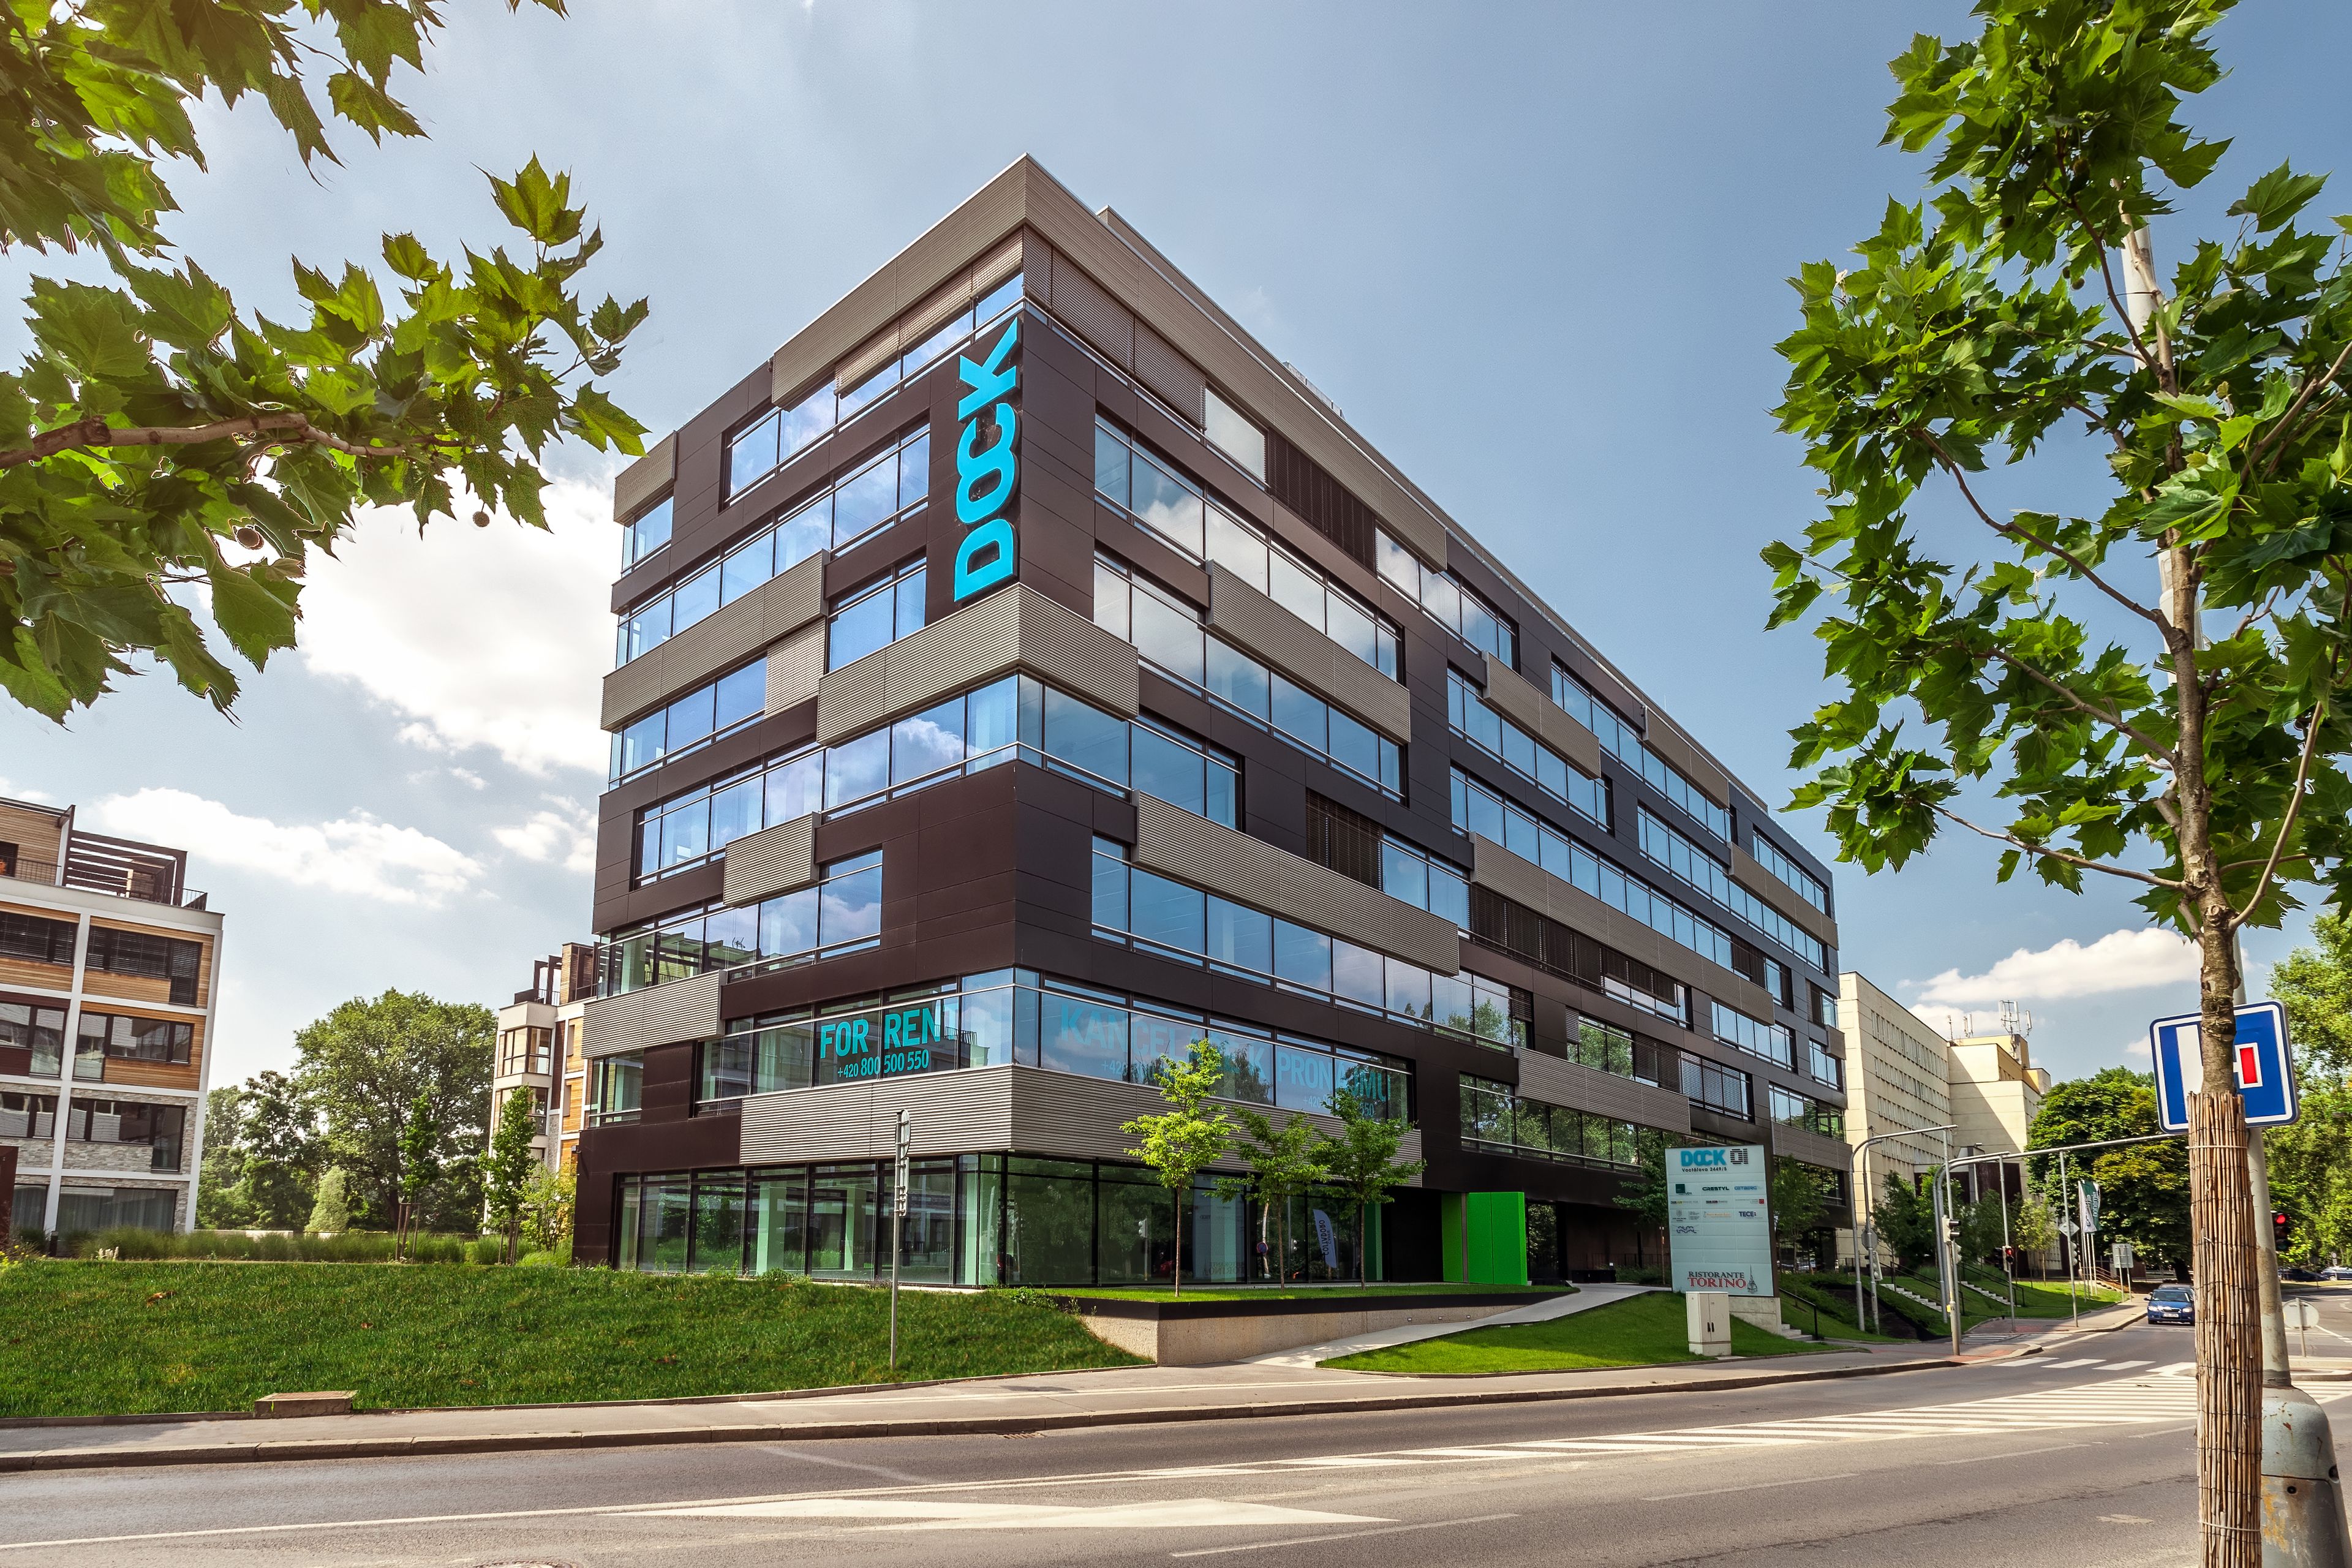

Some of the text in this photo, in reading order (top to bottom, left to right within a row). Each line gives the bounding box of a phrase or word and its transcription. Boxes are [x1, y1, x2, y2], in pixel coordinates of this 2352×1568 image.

[954, 316, 1020, 602] DOCK
[820, 1018, 870, 1059] FOR
[838, 1049, 929, 1078] +420 800 500 550
[1681, 1149, 1727, 1167] DOCK
[1687, 1277, 1747, 1288] TORINO
